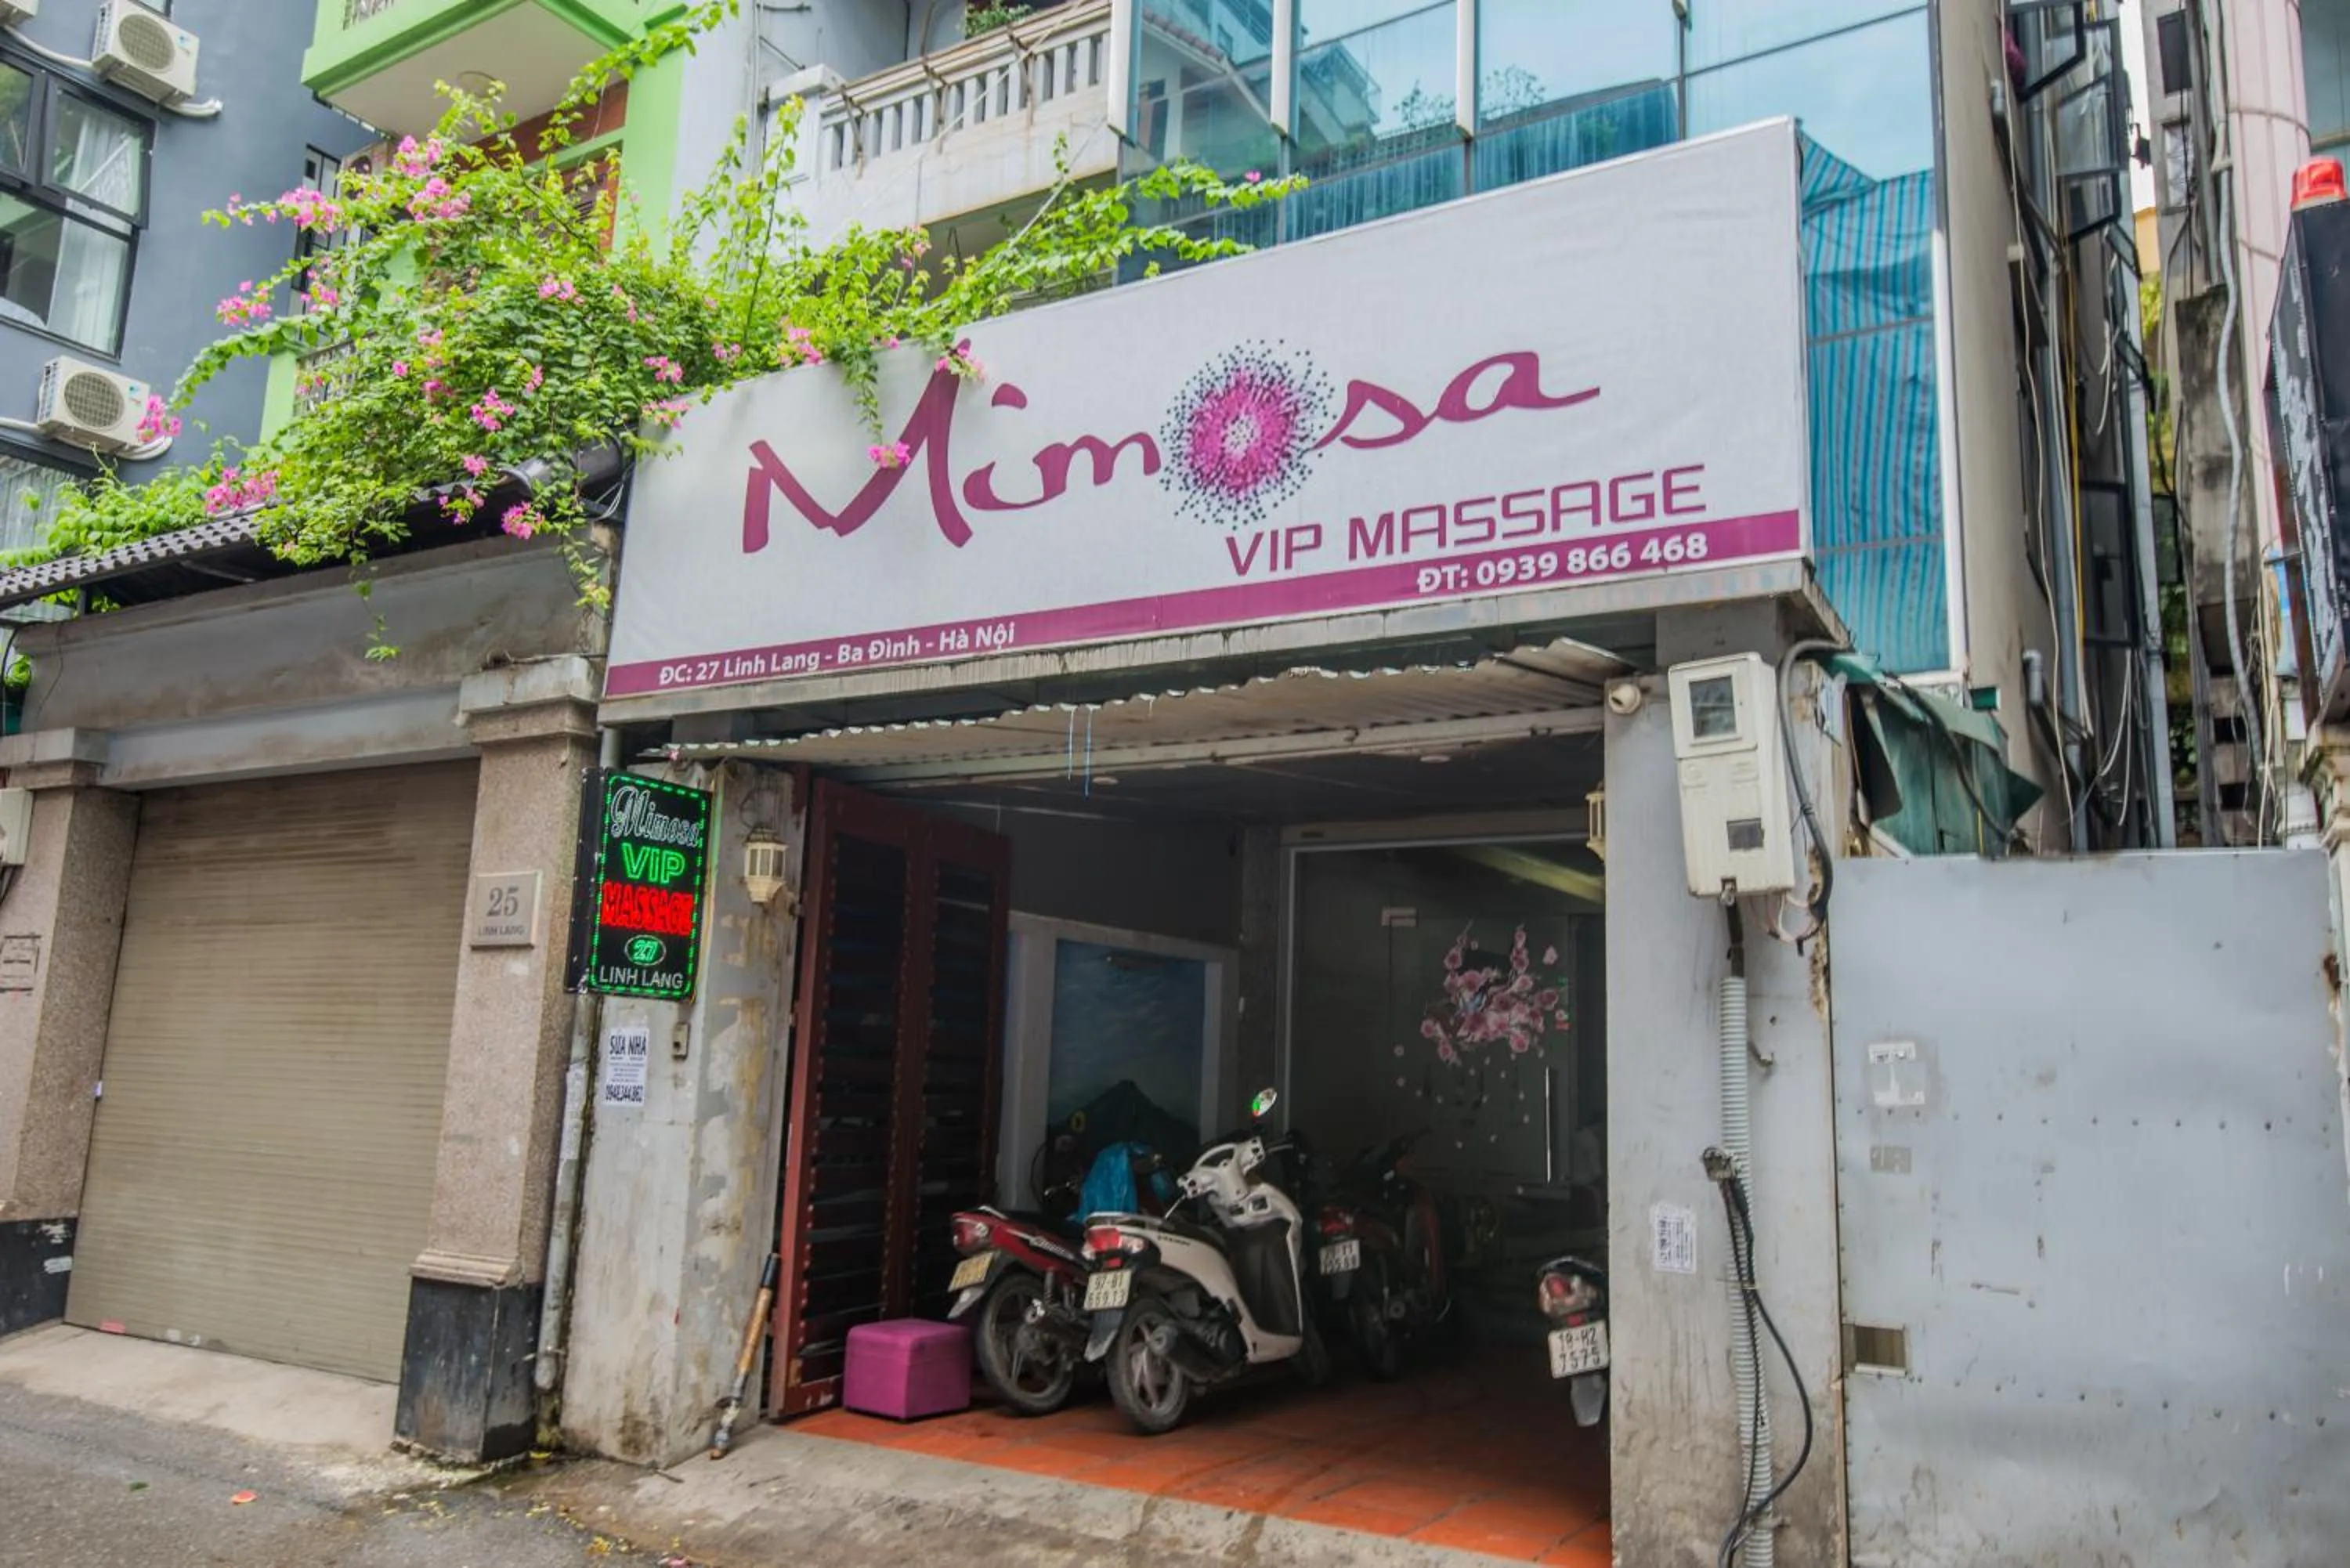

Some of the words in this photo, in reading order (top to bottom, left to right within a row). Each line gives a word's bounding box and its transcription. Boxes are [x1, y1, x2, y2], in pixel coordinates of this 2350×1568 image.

[1225, 522, 1322, 577] VIP
[1348, 464, 1707, 562] MASSAGE
[1416, 562, 1469, 594] ĐT:
[1477, 551, 1558, 587] 0939
[1567, 540, 1631, 574] 866
[1640, 532, 1708, 565] 468
[659, 664, 692, 686] ĐC:
[696, 660, 720, 681] 27
[723, 654, 765, 677] Linh
[771, 649, 820, 672] Lang
[837, 643, 862, 665] Ba
[867, 635, 920, 660] Đình
[939, 630, 970, 652] Hà
[975, 622, 1016, 651] Nội
[620, 842, 686, 885] VIP
[486, 885, 519, 917] 25
[632, 940, 660, 963] 27
[599, 965, 638, 986] LINH
[642, 968, 685, 989] LANG
